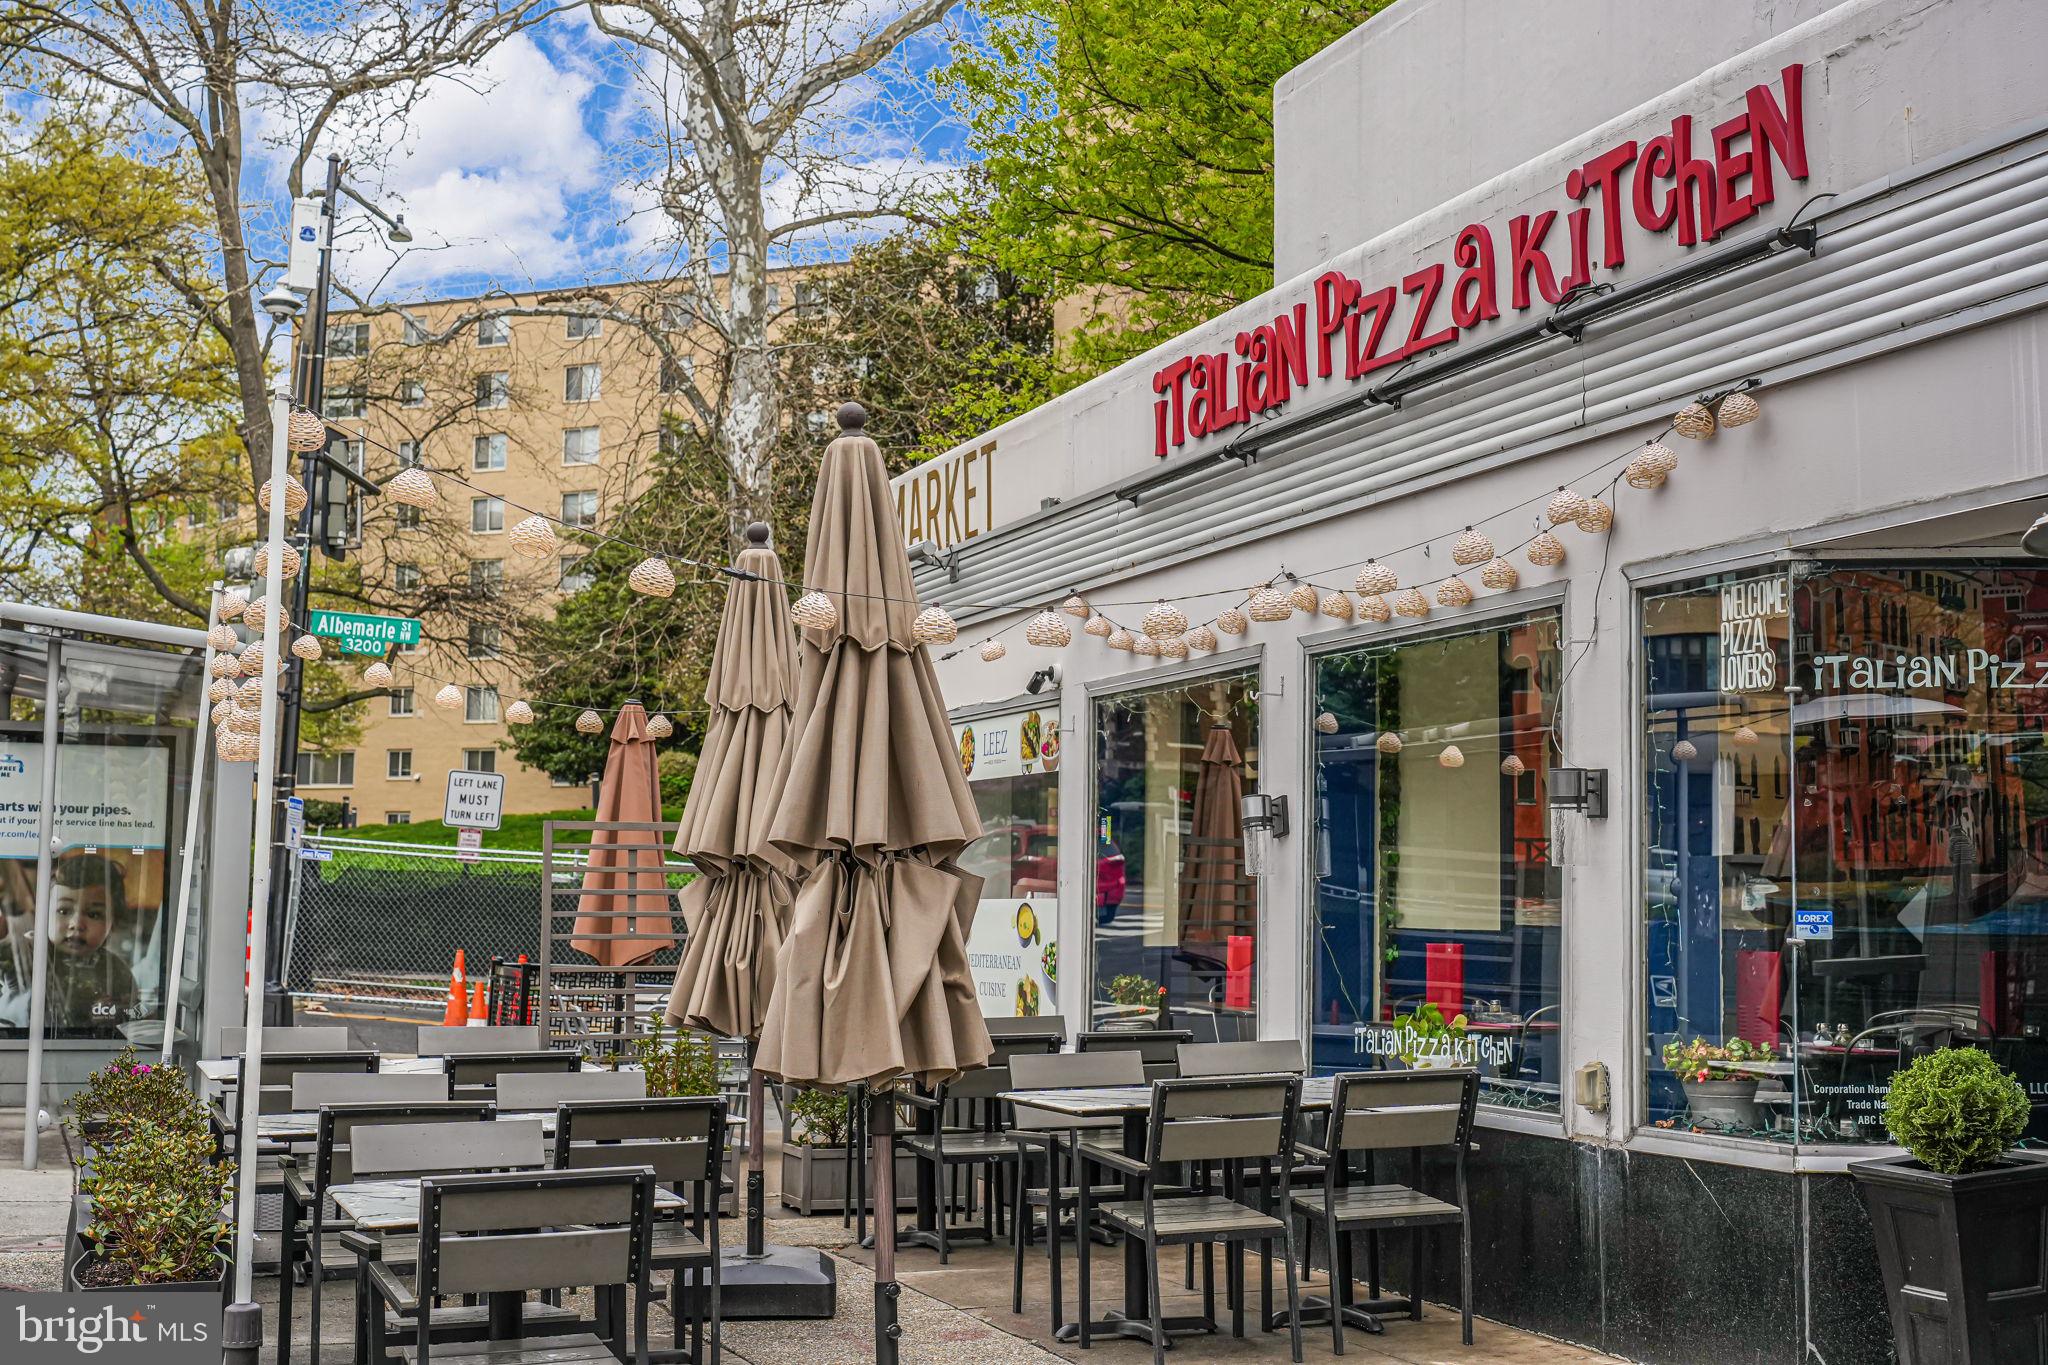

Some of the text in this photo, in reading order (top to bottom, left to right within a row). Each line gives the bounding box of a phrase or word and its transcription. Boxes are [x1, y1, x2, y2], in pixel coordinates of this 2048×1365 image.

[1721, 578, 1787, 621] WELCOME
[317, 614, 412, 639] Albemarle St
[1720, 618, 1766, 656] PIZZA
[346, 638, 382, 653] 3200
[1720, 652, 1773, 691] LOVERS
[983, 730, 1008, 756] LEEZ
[454, 778, 498, 790] LEFT LANE
[459, 794, 489, 806] MUST
[59, 803, 90, 816] your
[92, 803, 132, 817] pipes.
[450, 810, 495, 821] TURN LEFT
[8, 815, 15, 824] if
[17, 818, 37, 826] your
[66, 819, 97, 827] service
[99, 818, 115, 827] line
[117, 819, 133, 828] has
[134, 820, 156, 829] lead.
[1797, 914, 1830, 923] LOREX
[979, 981, 1007, 998] CUISINE
[1813, 1084, 1865, 1095] Corporation
[1846, 1100, 1872, 1109] Trade
[1857, 1115, 1877, 1125] ABC
